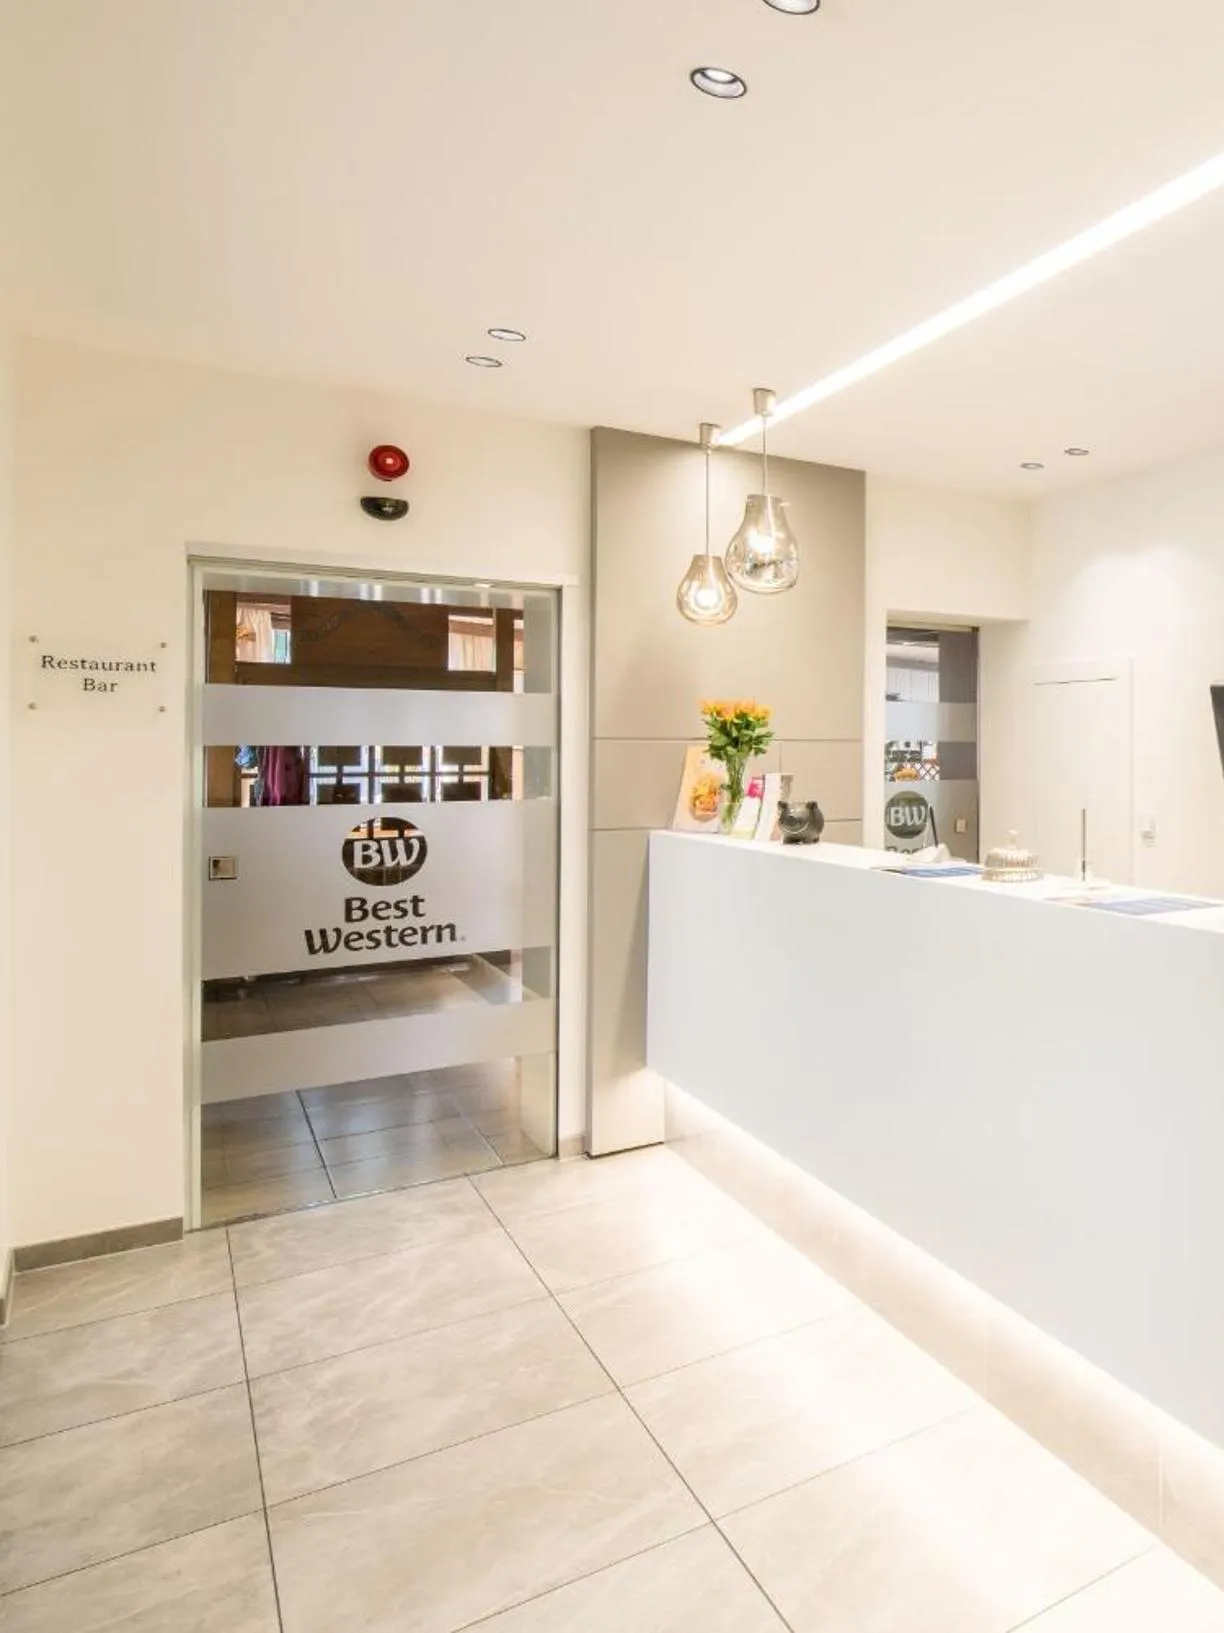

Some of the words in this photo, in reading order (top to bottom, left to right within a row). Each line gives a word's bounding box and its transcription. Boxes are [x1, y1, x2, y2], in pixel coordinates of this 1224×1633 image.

[41, 654, 157, 673] Restaurant
[82, 677, 118, 693] Bar
[890, 805, 926, 827] BW
[352, 837, 420, 869] BW
[344, 894, 427, 924] Best
[303, 922, 458, 956] Western
